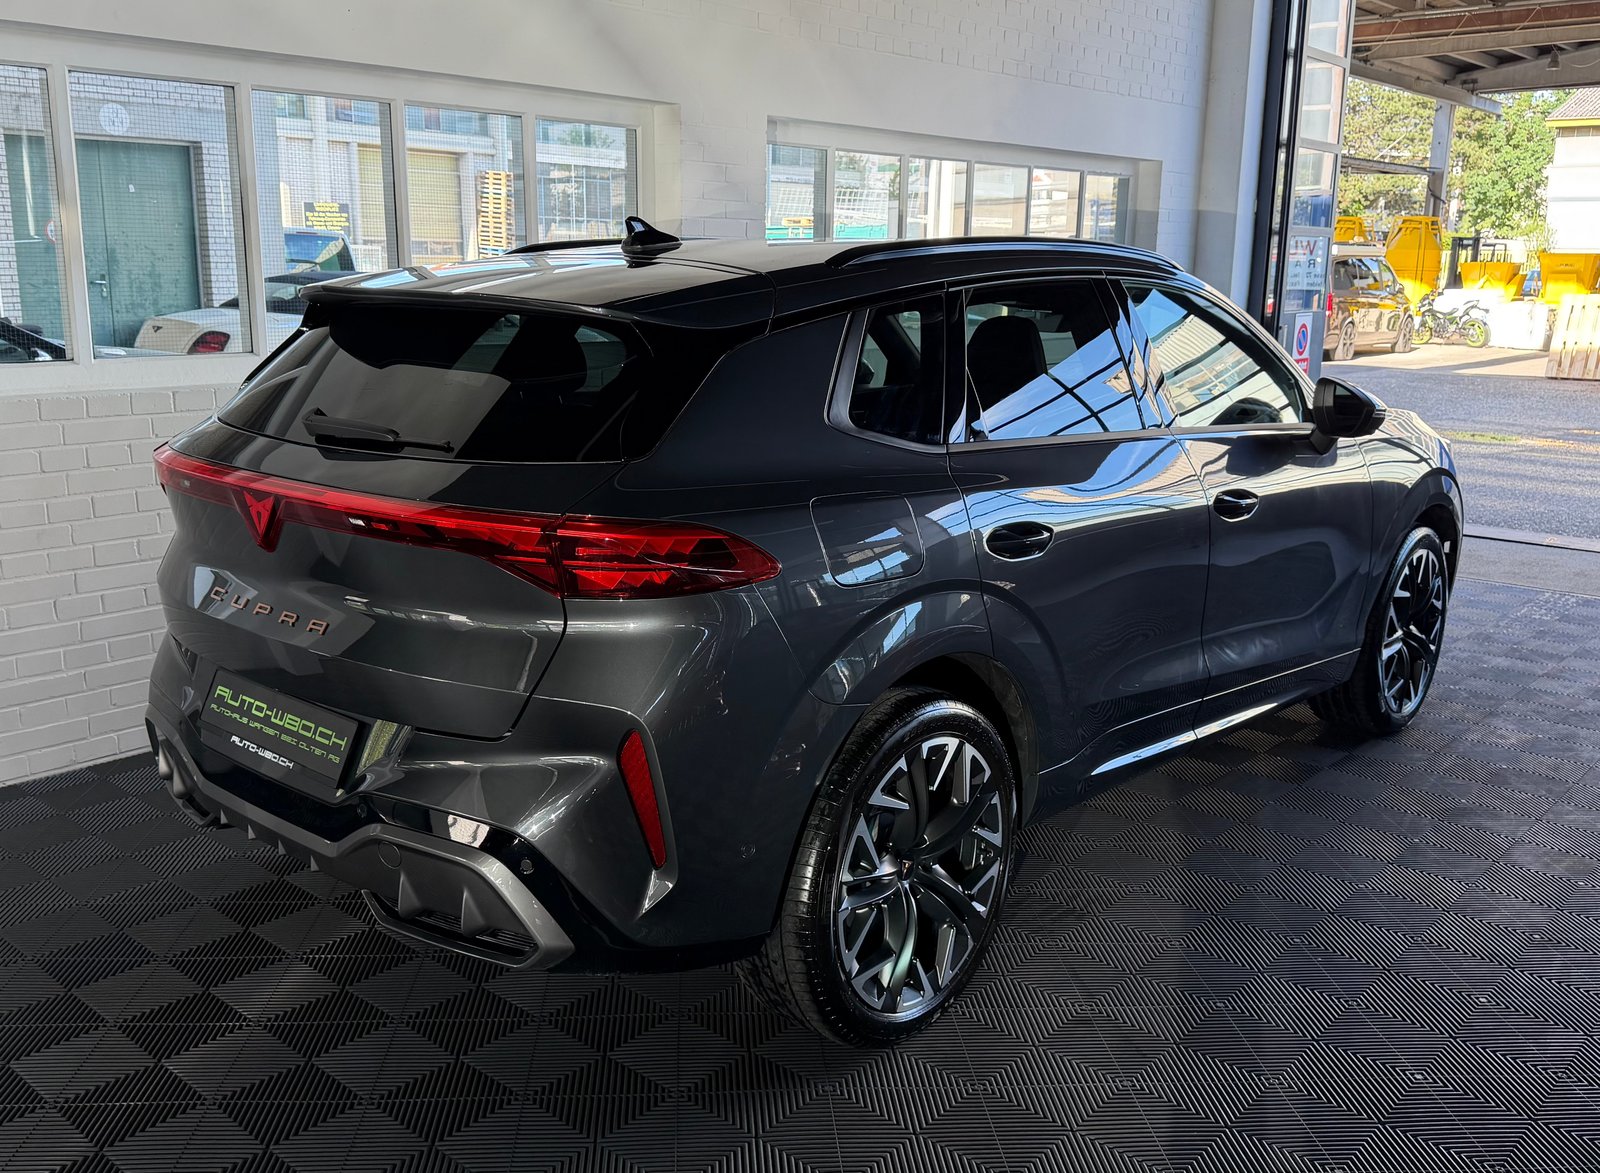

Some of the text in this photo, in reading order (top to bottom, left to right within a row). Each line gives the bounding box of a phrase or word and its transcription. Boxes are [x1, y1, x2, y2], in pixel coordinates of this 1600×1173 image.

[210, 586, 330, 636] CUPRA
[210, 703, 249, 724] AUTOHAUS
[328, 753, 341, 764] AG
[214, 685, 348, 751] AUTO-WBO.CH
[230, 735, 295, 770] AUTO-WBO.CH
